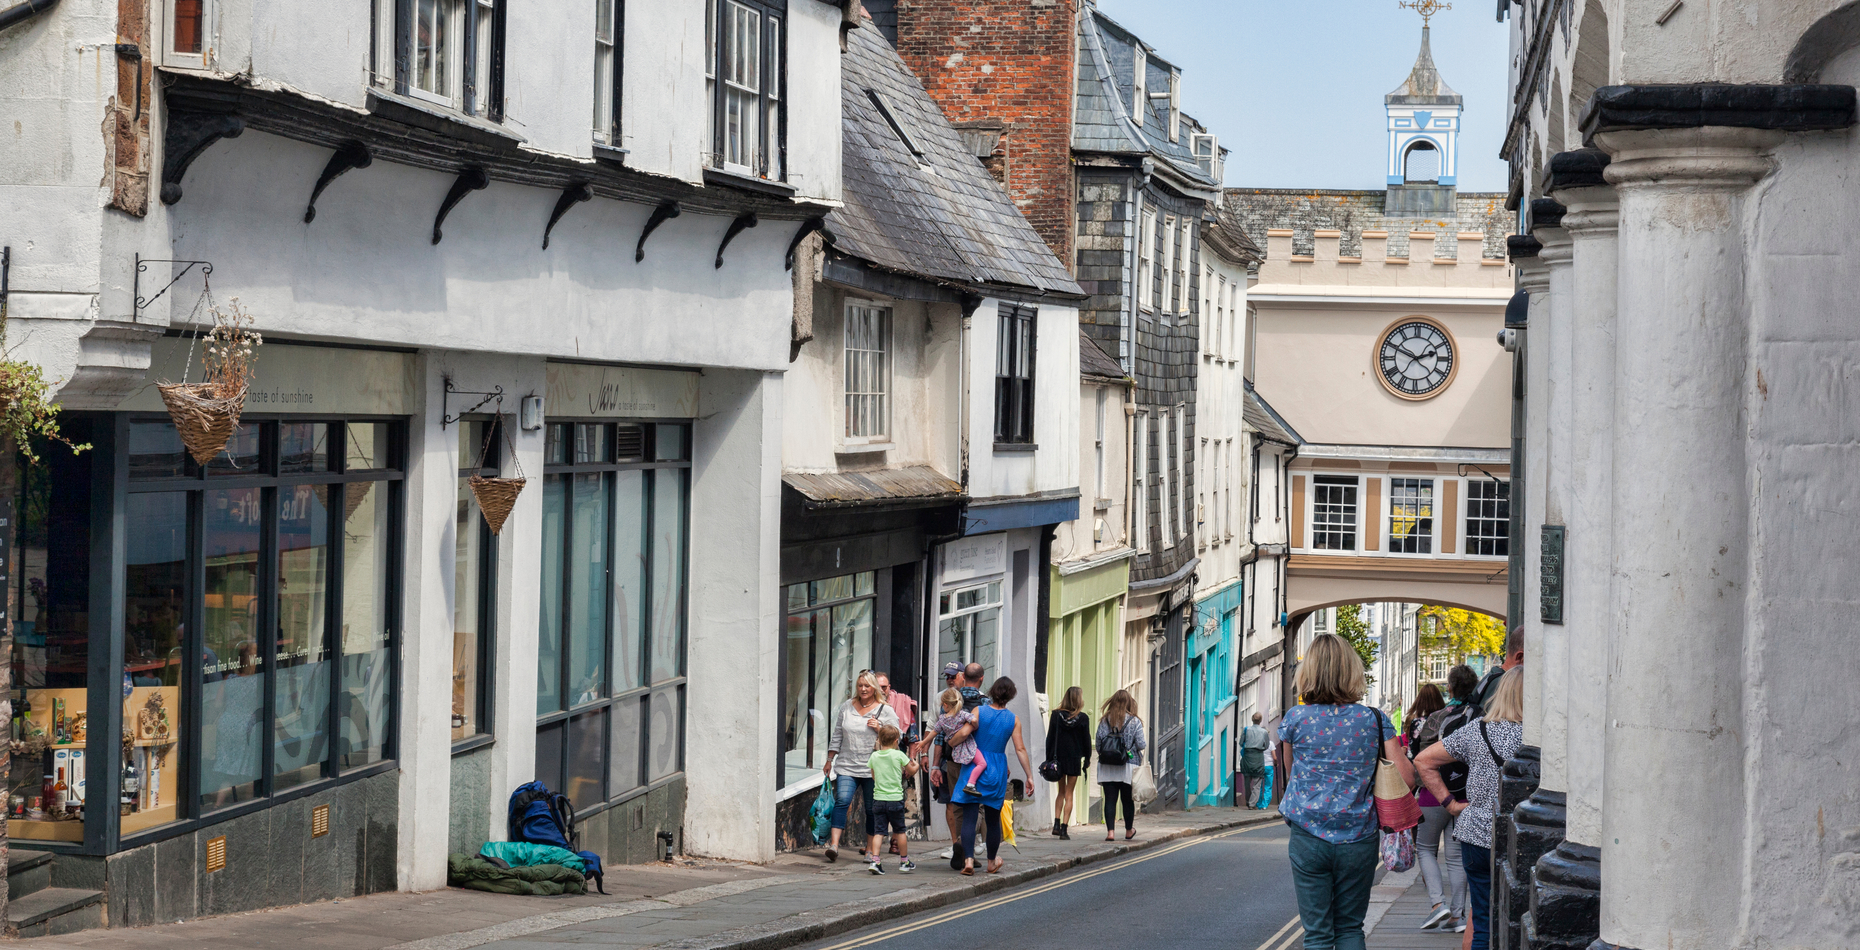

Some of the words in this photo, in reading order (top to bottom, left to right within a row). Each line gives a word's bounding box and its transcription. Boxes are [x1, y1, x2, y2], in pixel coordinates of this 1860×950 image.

[1398, 1, 1407, 9] N
[1446, 2, 1453, 11] S
[249, 389, 268, 403] taste
[270, 386, 279, 403] of
[281, 387, 313, 404] sunshine
[248, 655, 263, 667] Wine
